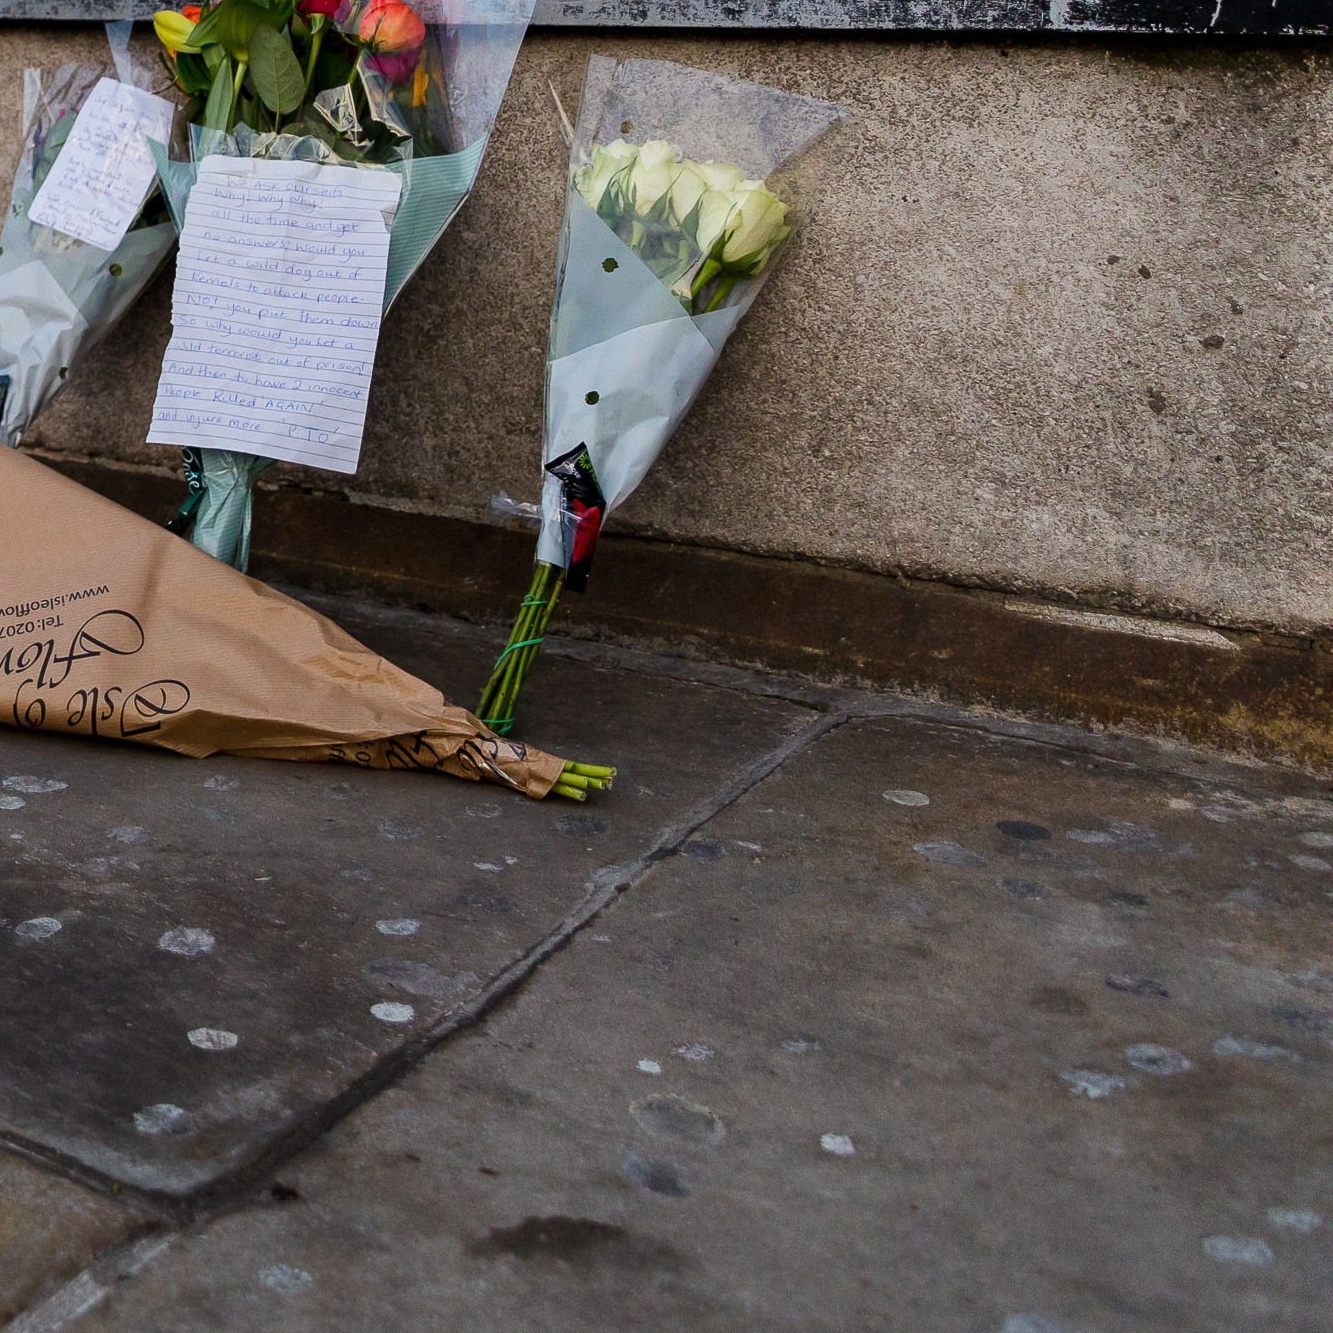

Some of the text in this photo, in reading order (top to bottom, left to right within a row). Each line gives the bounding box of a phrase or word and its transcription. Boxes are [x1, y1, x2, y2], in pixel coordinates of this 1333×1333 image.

[241, 212, 261, 225] the
[266, 213, 299, 227] time
[305, 218, 333, 231] and
[336, 220, 361, 237] get
[339, 247, 365, 263] you
[284, 263, 313, 282] dog
[316, 269, 340, 279] out
[245, 281, 258, 292] to
[263, 285, 308, 299] attack
[222, 302, 252, 317] you
[205, 318, 232, 337] why
[238, 326, 283, 340] would
[288, 334, 313, 349] you
[268, 354, 292, 366] out
[198, 364, 228, 379] then
[254, 376, 286, 389] have
[291, 378, 303, 391] 2
[307, 384, 366, 399] innocent
[36, 614, 65, 629] Tel:
[66, 678, 191, 738] Isle
